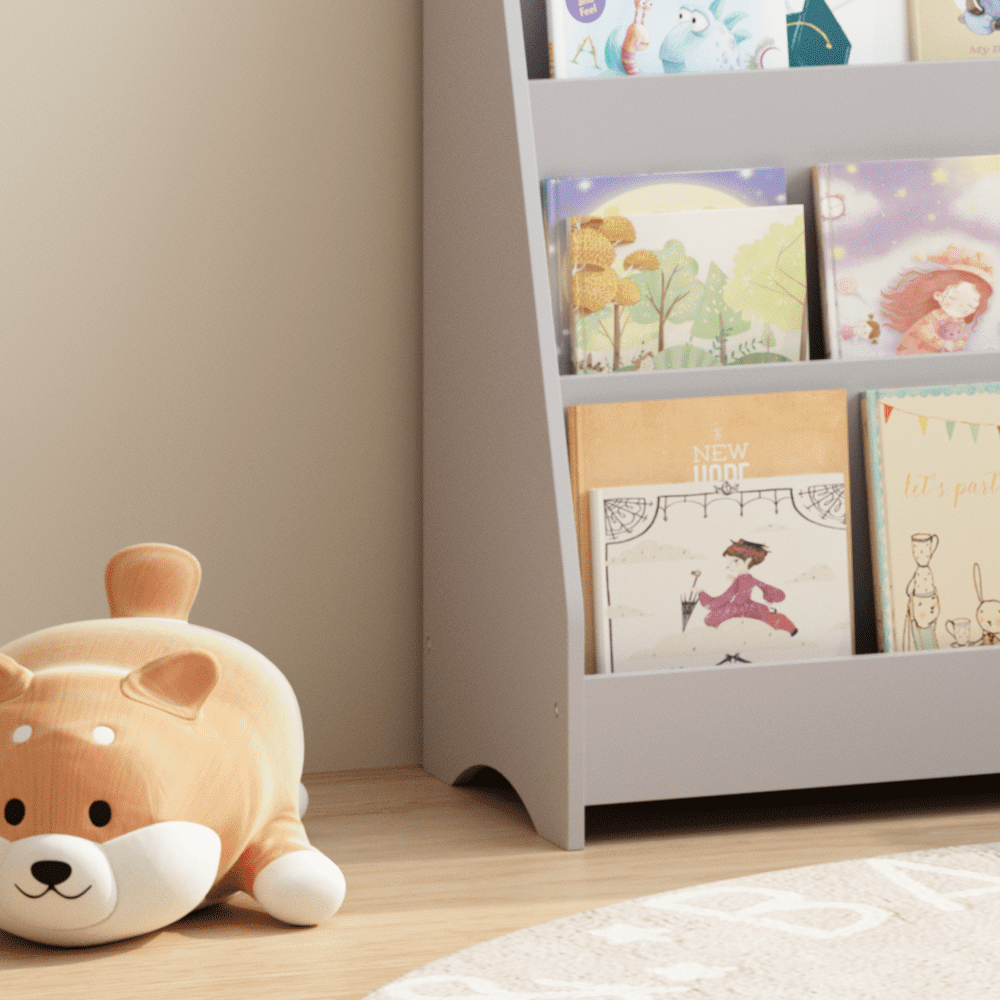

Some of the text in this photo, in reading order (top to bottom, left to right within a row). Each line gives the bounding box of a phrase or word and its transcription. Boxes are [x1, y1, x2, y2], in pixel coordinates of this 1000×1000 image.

[578, 3, 598, 18] Feel
[968, 45, 990, 56] My
[692, 441, 750, 463] NEW
[904, 472, 945, 498] let's
